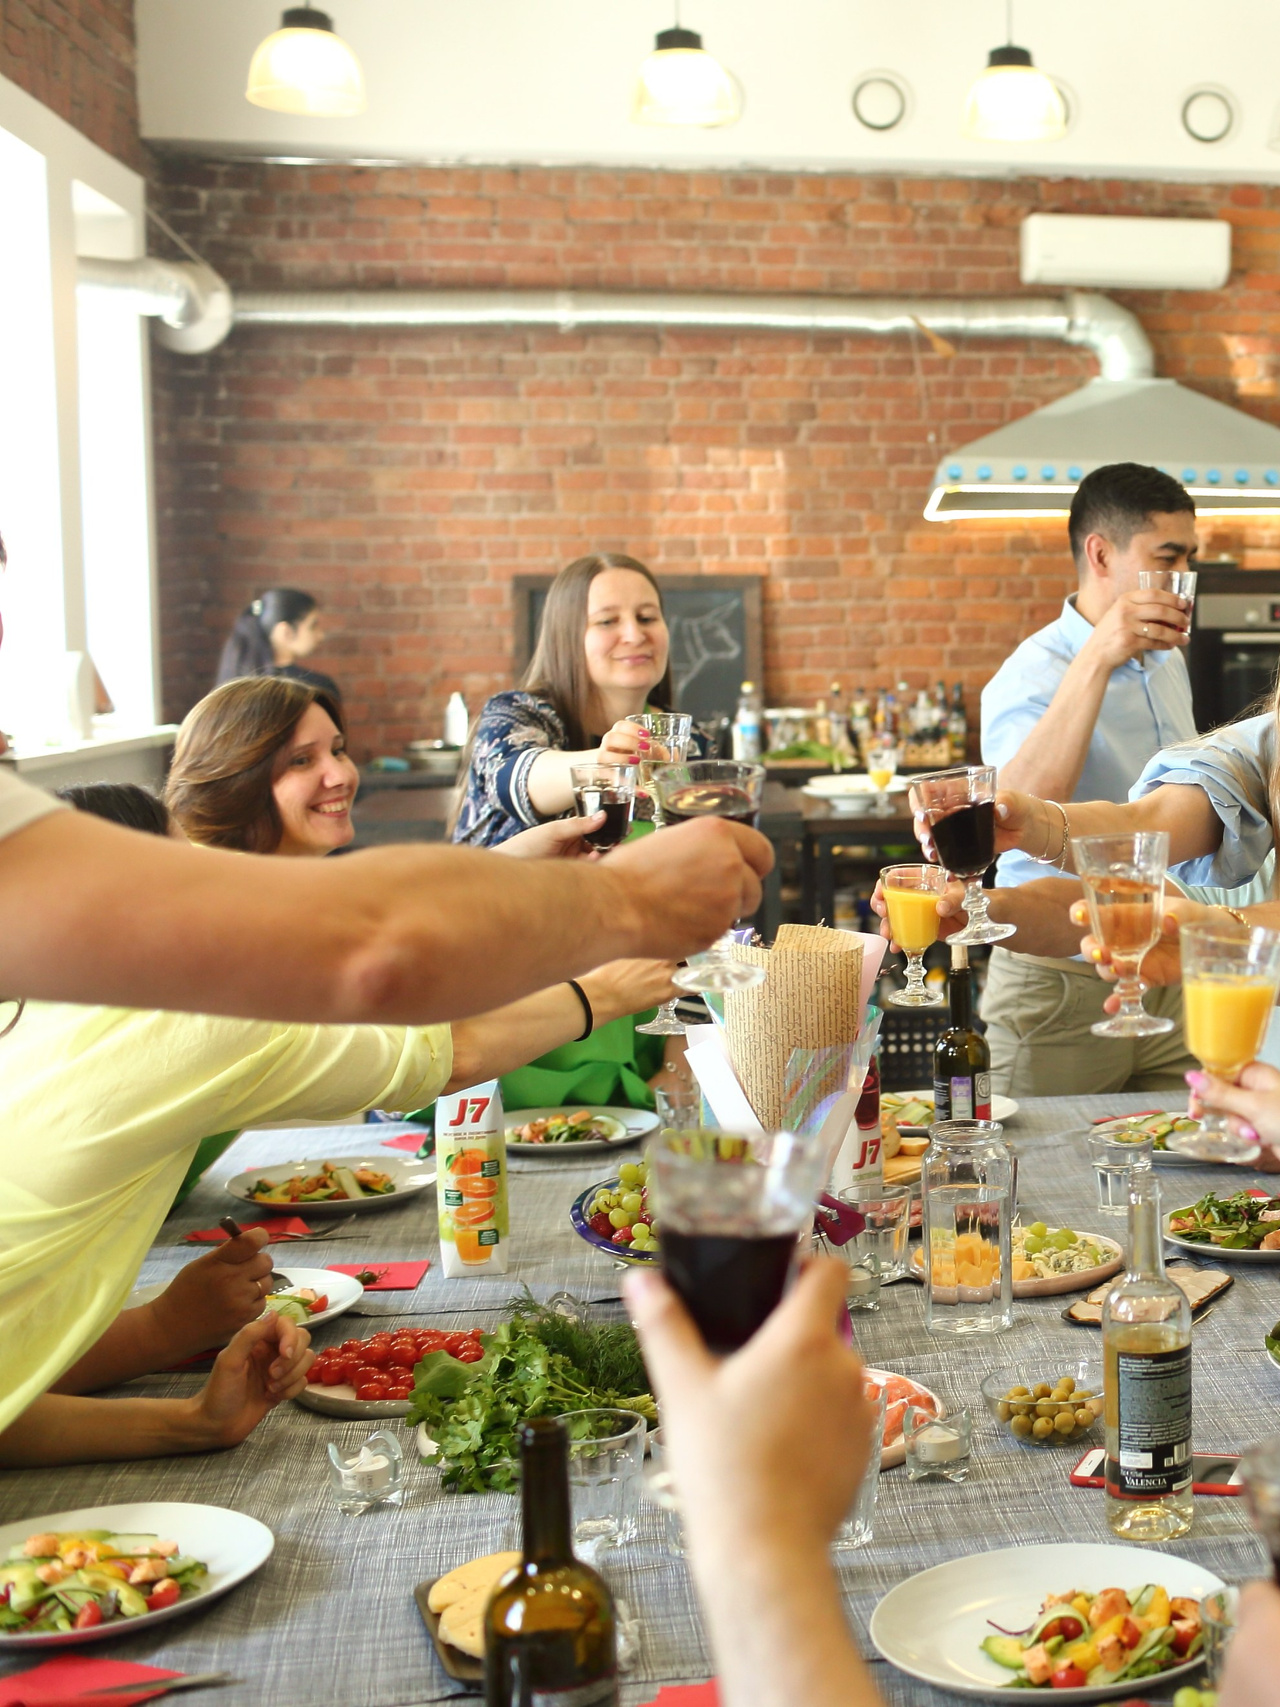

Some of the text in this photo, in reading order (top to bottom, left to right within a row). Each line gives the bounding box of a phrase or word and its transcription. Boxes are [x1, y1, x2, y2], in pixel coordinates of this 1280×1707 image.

[449, 1098, 490, 1126] J7
[852, 1138, 881, 1170] J7
[1125, 1476, 1167, 1486] VALENCIA
